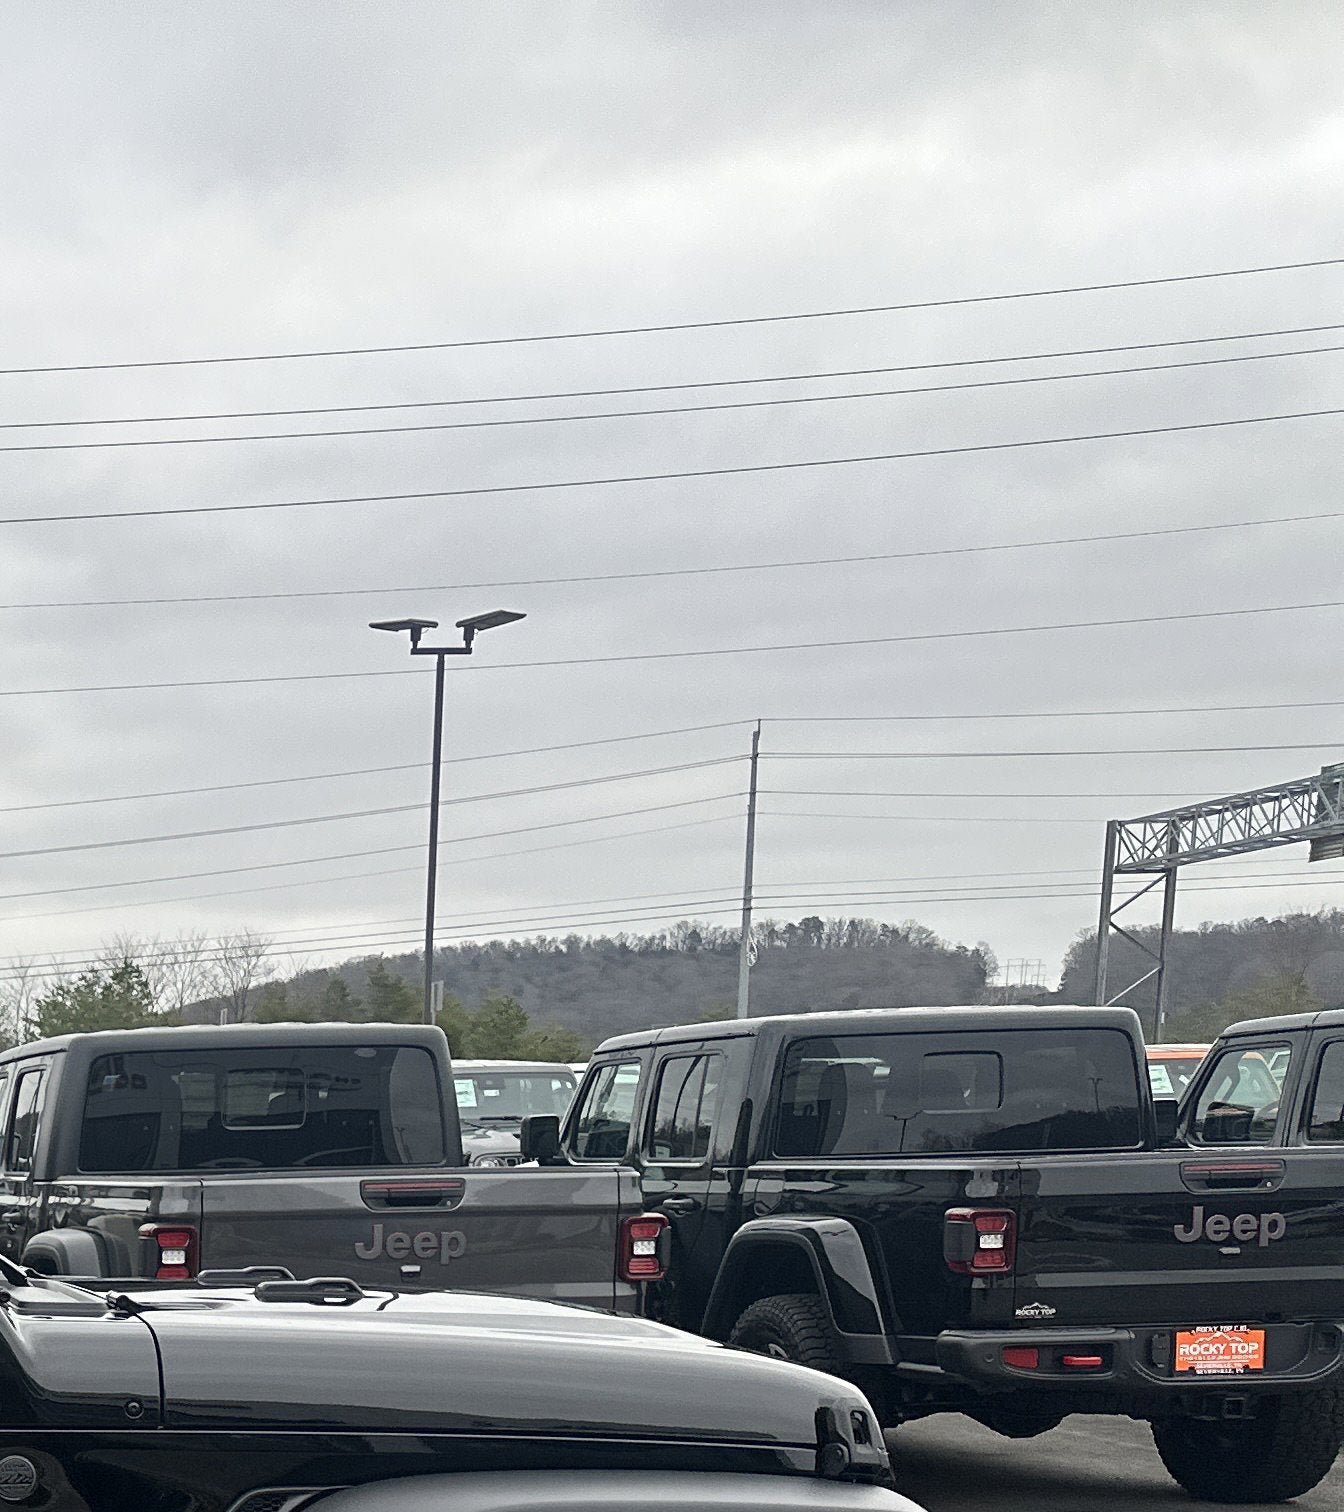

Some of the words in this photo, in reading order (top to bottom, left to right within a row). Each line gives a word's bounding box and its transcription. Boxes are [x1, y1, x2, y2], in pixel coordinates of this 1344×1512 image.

[355, 1224, 467, 1265] Jeep
[1173, 1206, 1286, 1247] Jeep
[1179, 1343, 1227, 1356] ROCKY
[1229, 1342, 1259, 1355] TOP
